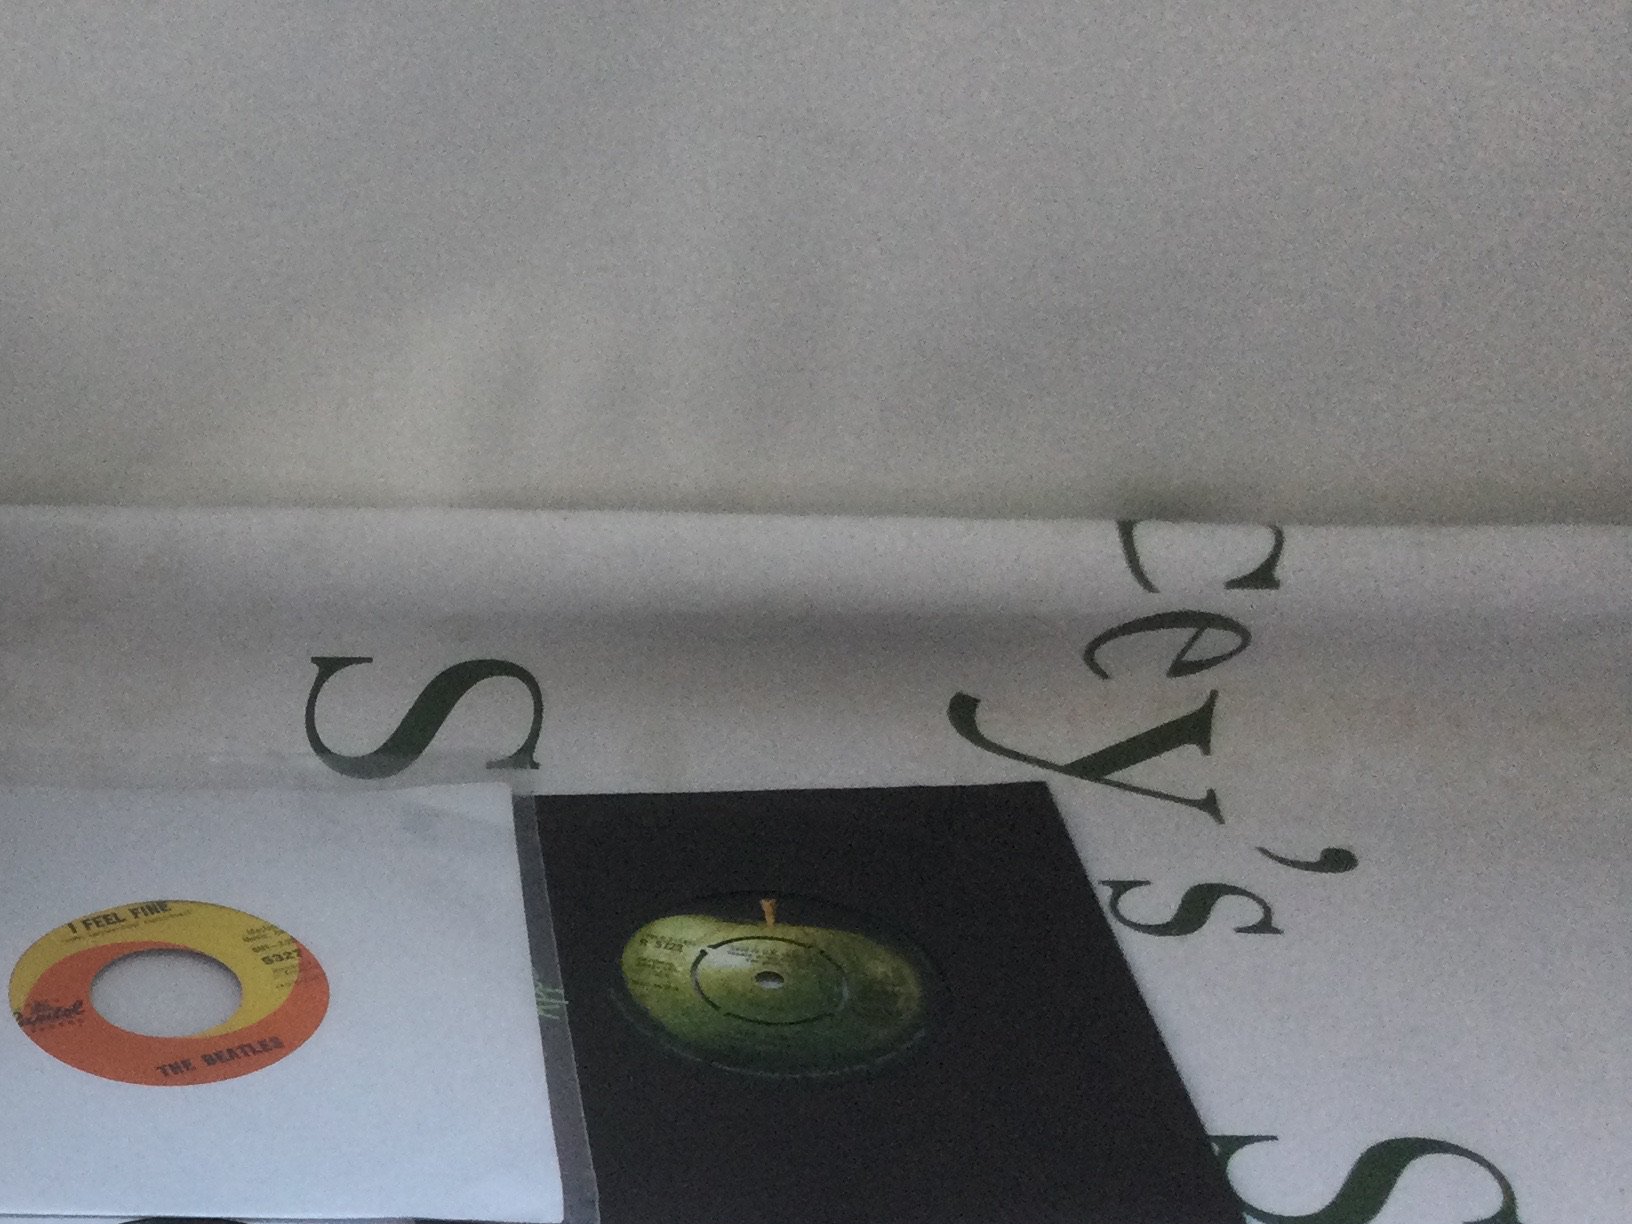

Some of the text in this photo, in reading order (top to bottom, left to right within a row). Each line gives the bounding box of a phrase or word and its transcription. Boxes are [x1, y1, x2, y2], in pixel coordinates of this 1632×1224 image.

[81, 911, 127, 931] FEEL
[128, 900, 172, 920] FINE
[156, 1036, 285, 1078] THE BEATLES
